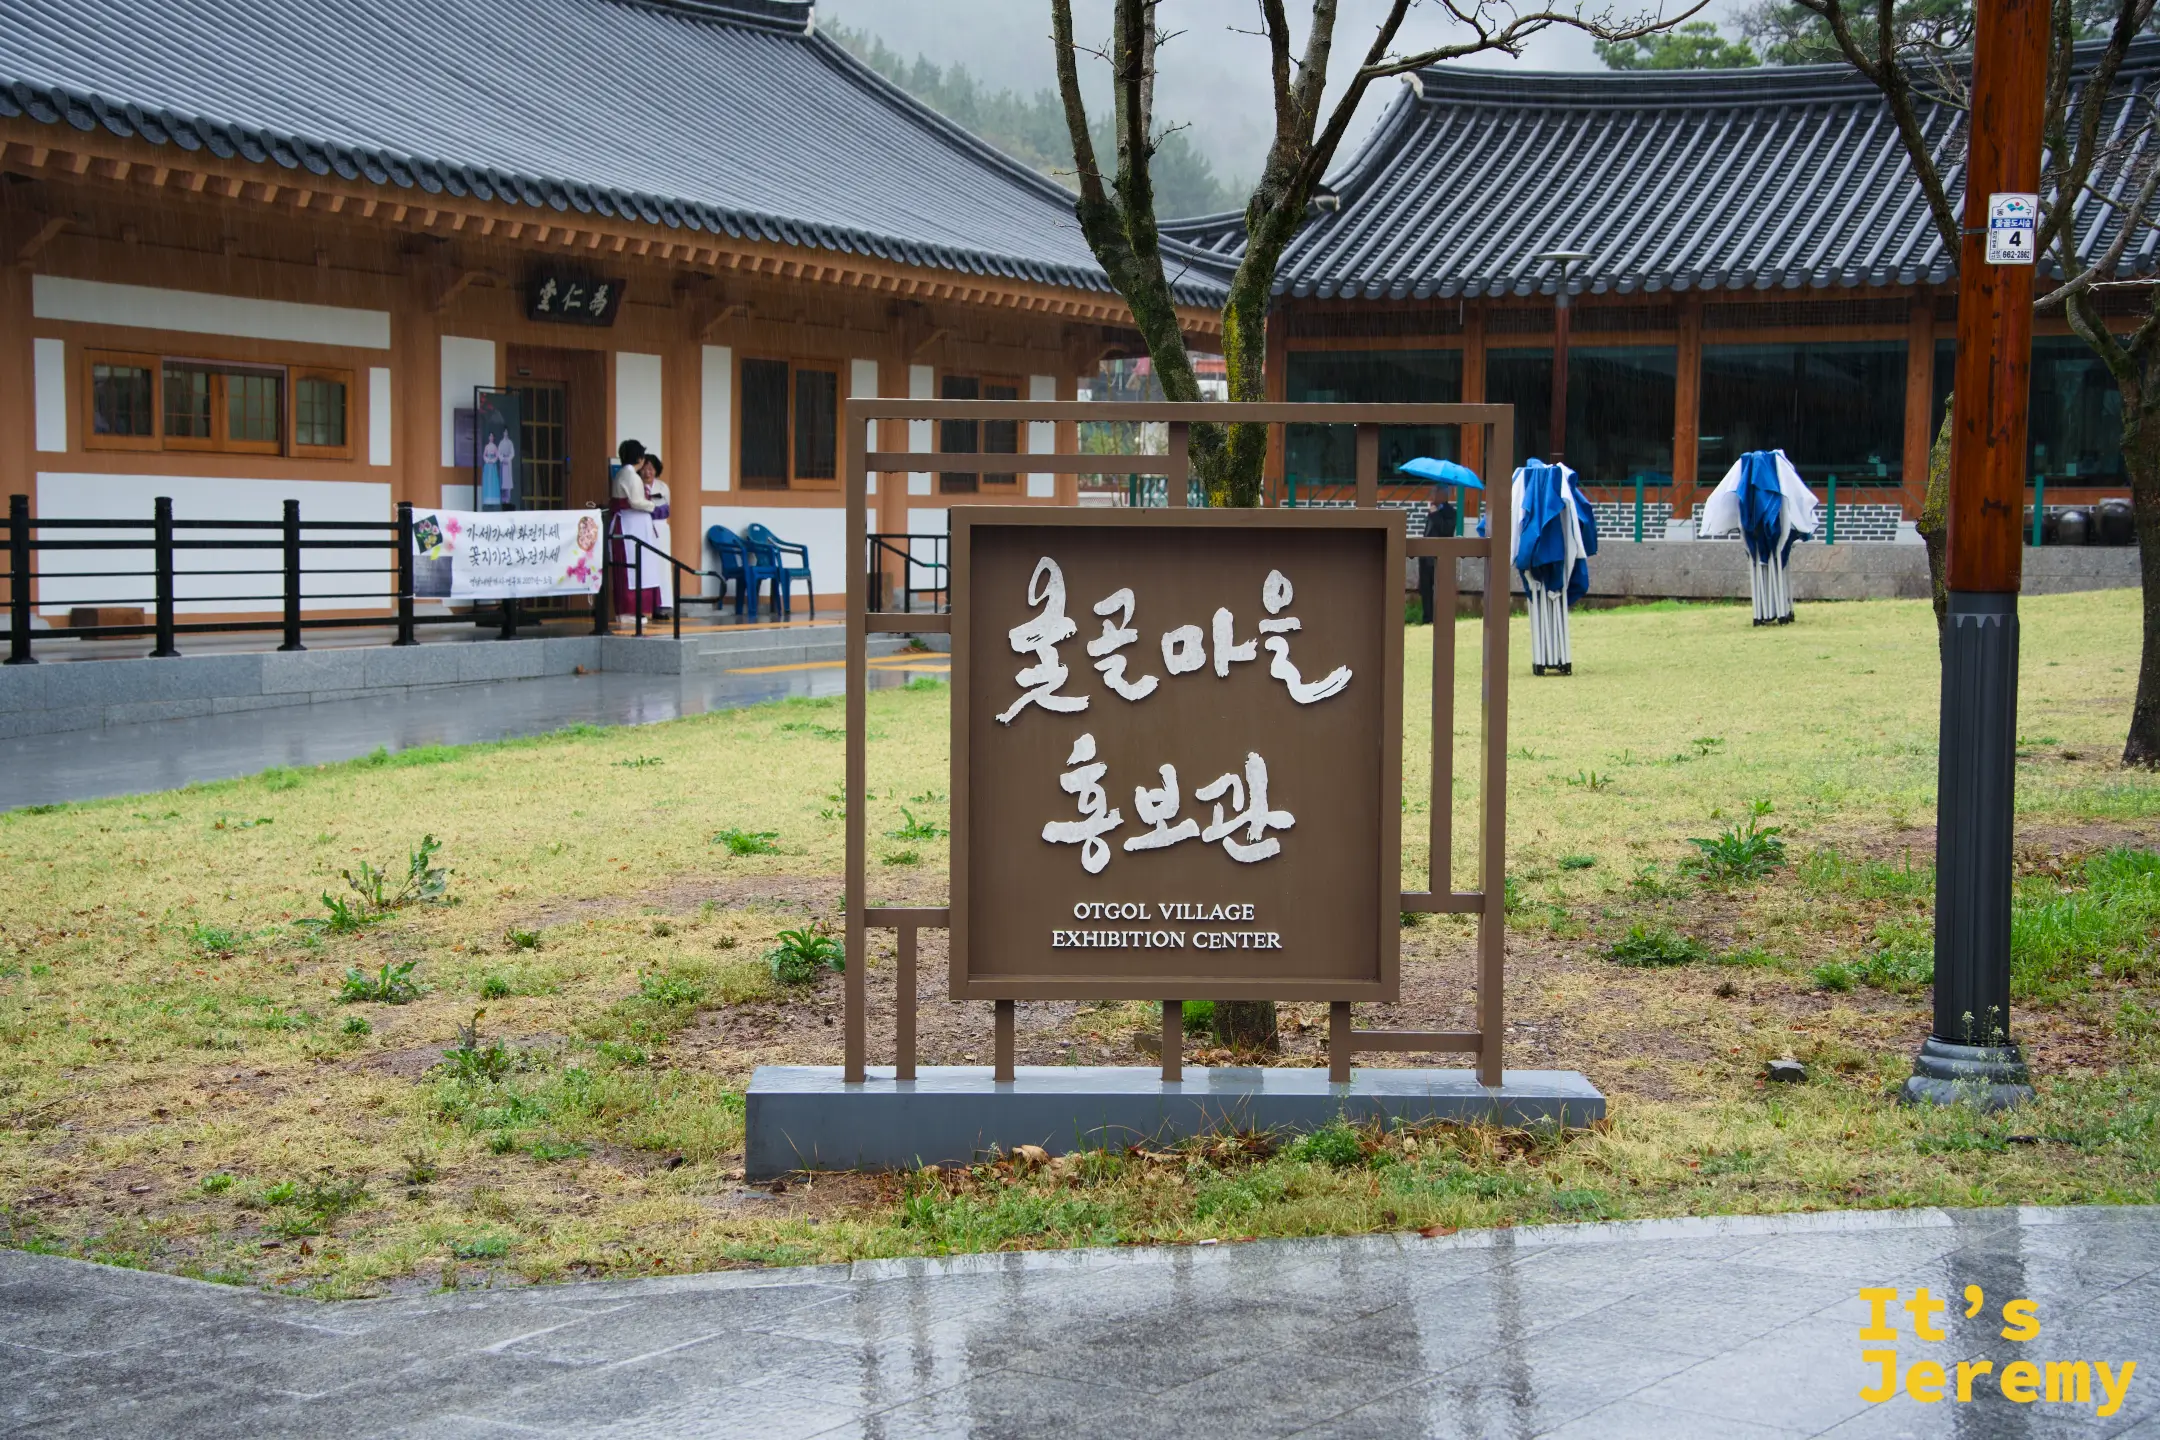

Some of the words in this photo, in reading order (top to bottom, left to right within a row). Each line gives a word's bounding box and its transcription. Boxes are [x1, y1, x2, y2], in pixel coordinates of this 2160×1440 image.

[2008, 231, 2022, 247] 4
[995, 556, 1353, 726] 옻골마을
[1041, 732, 1296, 874] 홍보관
[1073, 902, 1152, 920] OTGOL
[1157, 903, 1255, 921] VILLAGE
[1051, 930, 1186, 948] EXHIBITION
[1192, 931, 1283, 949] CENTER
